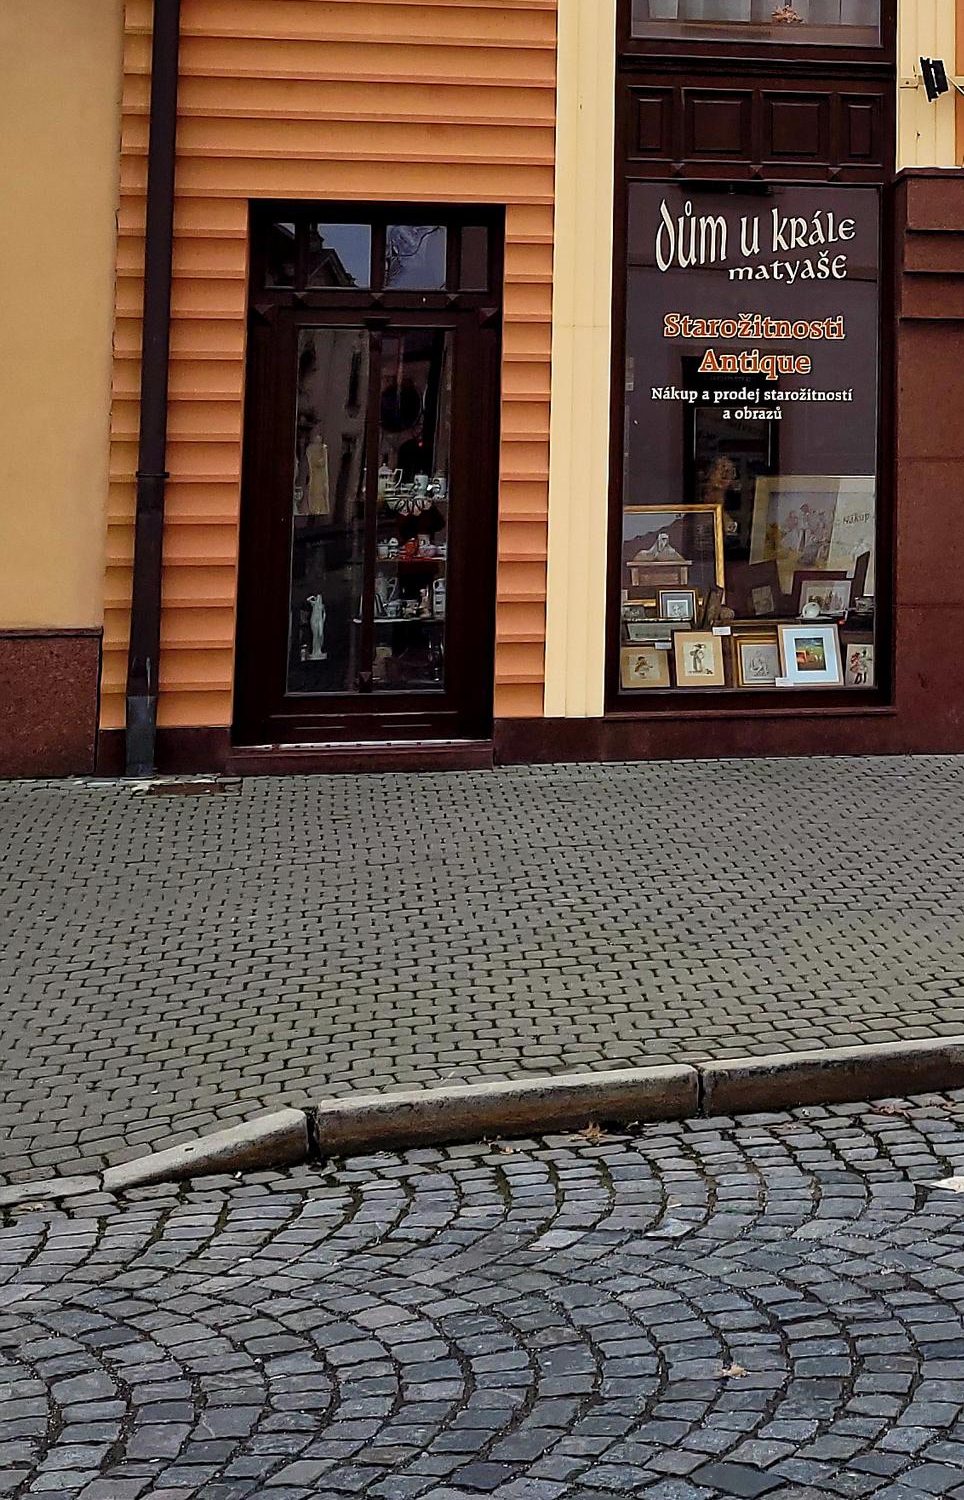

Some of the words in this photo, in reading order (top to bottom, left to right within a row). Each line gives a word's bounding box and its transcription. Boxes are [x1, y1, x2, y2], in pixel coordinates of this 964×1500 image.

[740, 216, 761, 257] u
[663, 312, 845, 340] Starožitnosti
[697, 349, 812, 380] Antique
[651, 387, 698, 403] Nákup
[702, 391, 710, 400] a
[714, 387, 760, 403] prodej
[722, 409, 731, 419] a
[734, 406, 783, 420] obrazů
